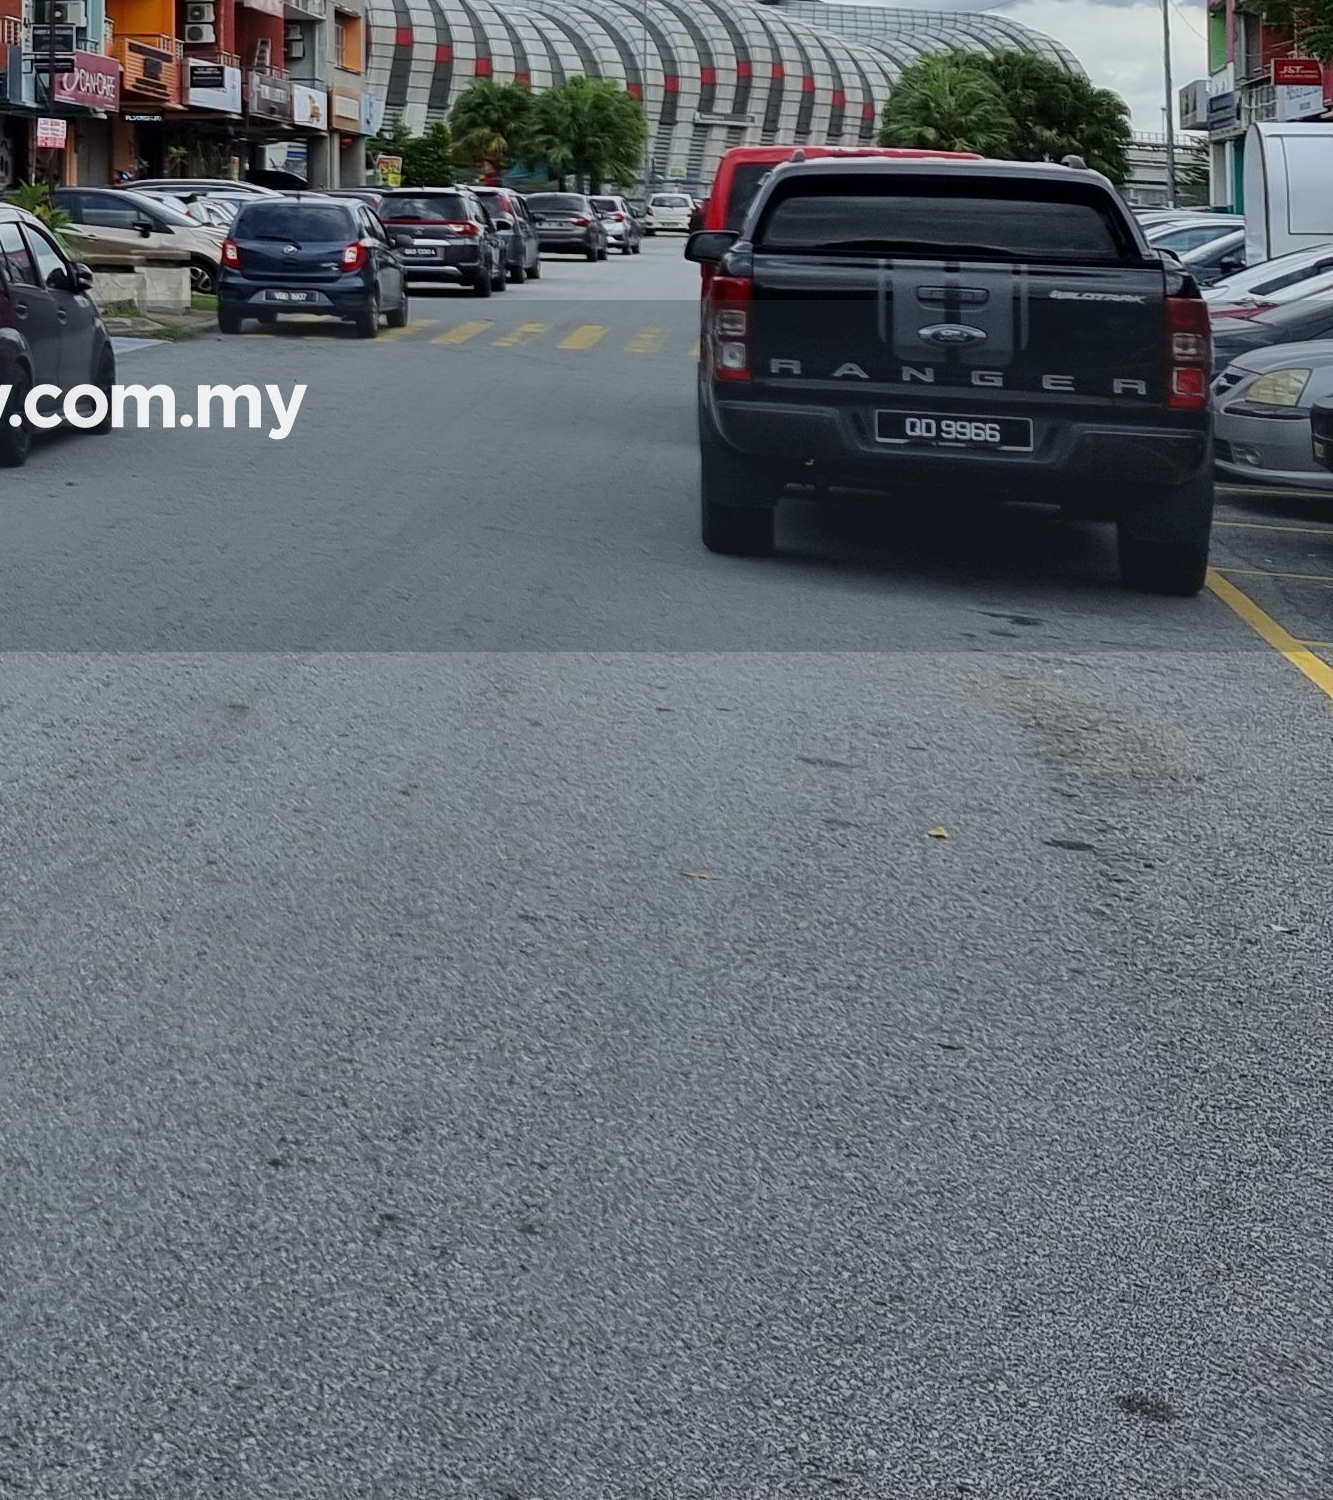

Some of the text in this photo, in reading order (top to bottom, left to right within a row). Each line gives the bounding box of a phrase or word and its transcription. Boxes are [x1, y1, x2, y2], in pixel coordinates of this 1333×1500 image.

[770, 357, 1148, 396] RANGER
[905, 417, 1001, 443] QD 9966
